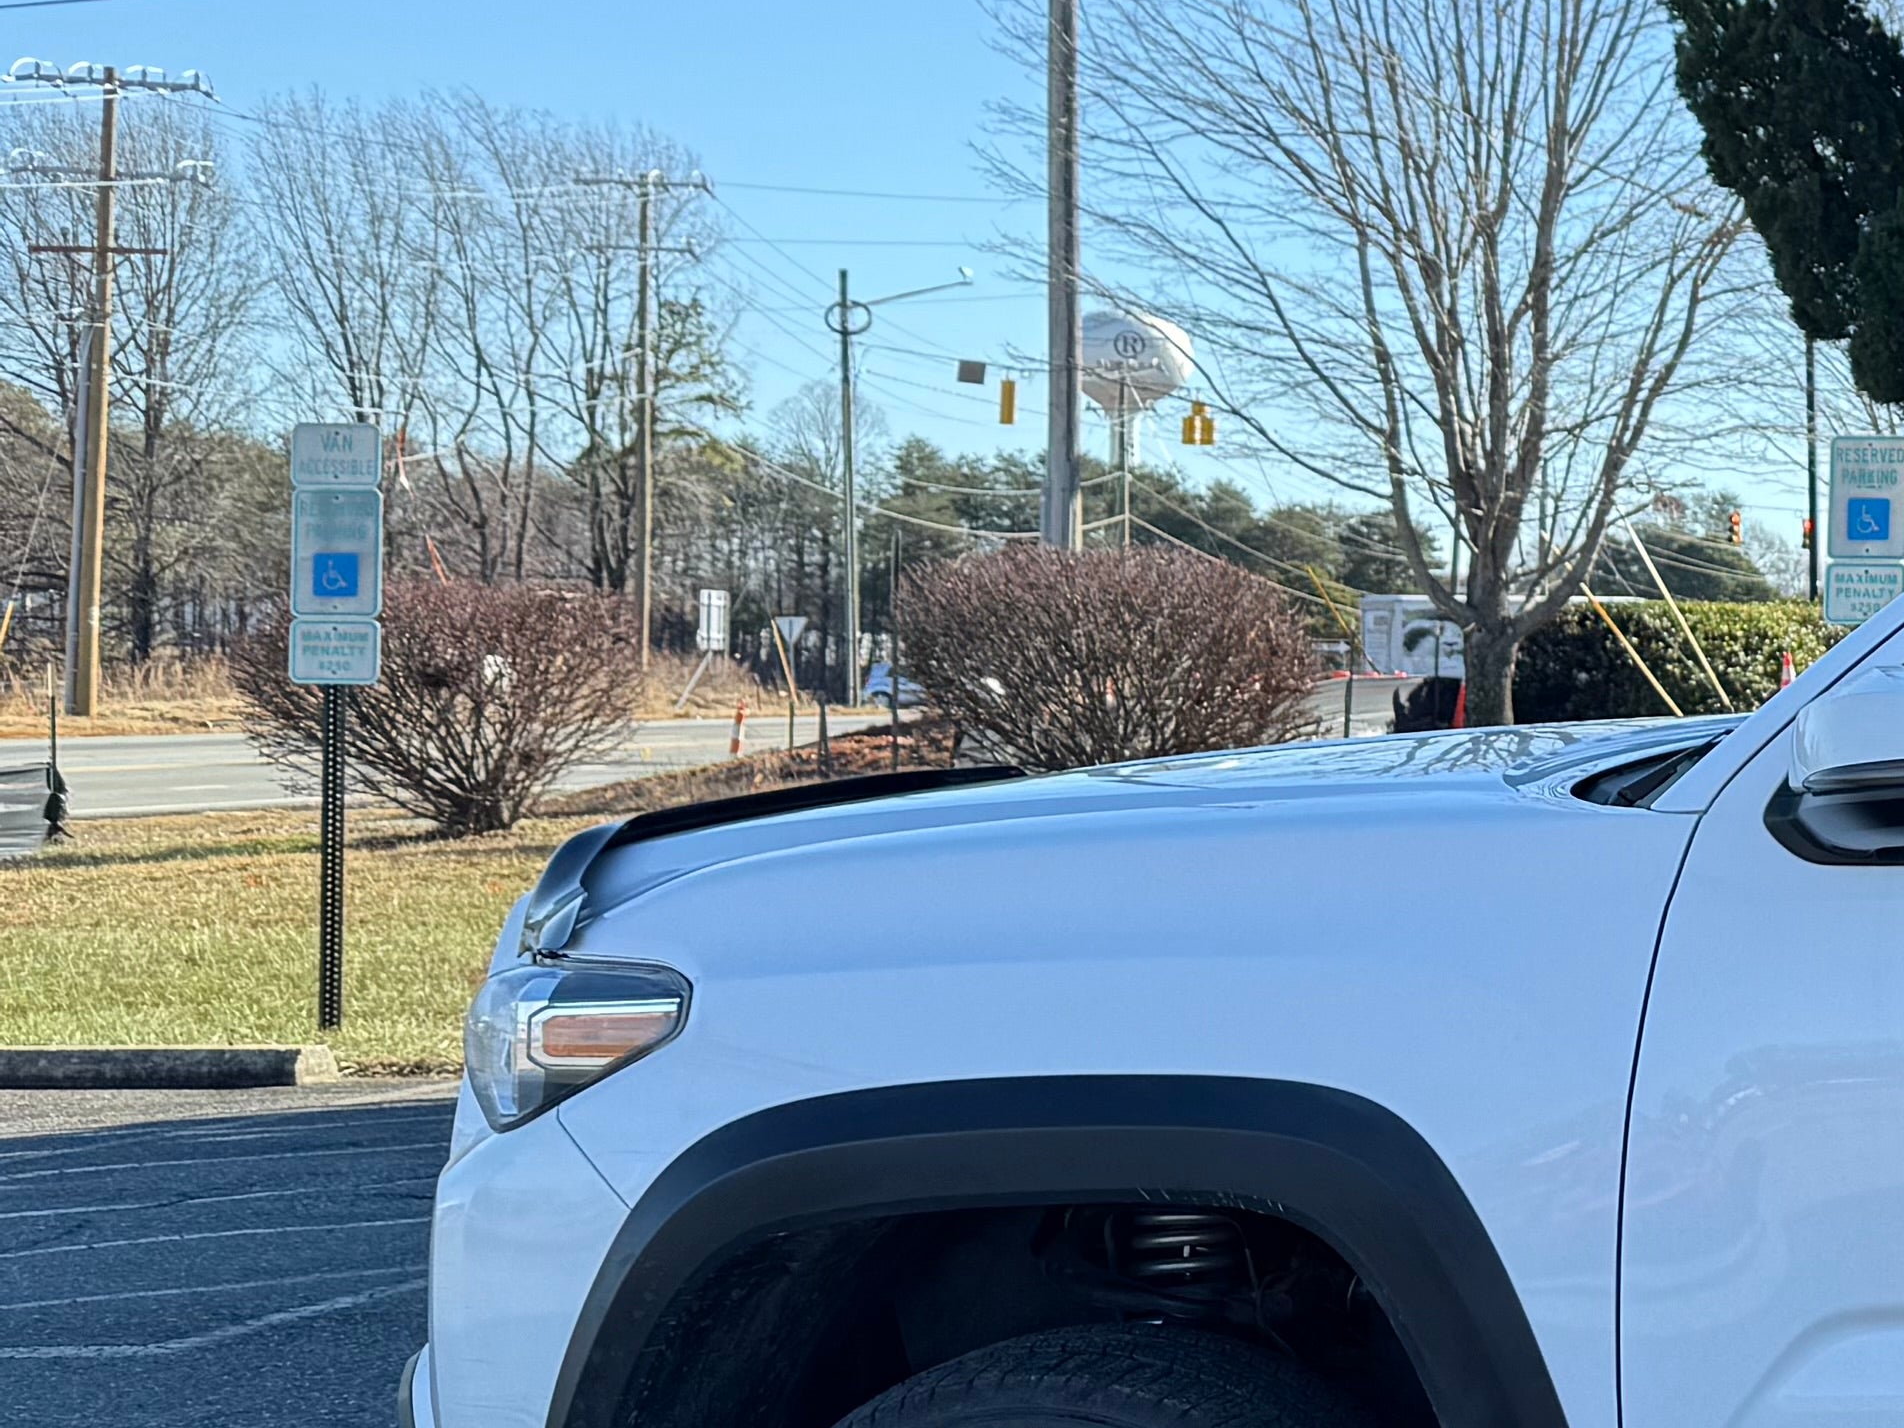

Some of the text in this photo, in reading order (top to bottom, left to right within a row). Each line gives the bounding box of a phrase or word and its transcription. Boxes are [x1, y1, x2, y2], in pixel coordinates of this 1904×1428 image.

[319, 434, 352, 452] VAN
[1836, 447, 1904, 464] RESERVED
[299, 458, 373, 475] ACCESSIBLE
[1841, 468, 1898, 484] PARKING
[1834, 573, 1898, 584] MAXIMUM
[1836, 587, 1895, 598] PENALTY
[301, 631, 369, 642] MAXIMUM
[301, 646, 366, 656] PENALTY
